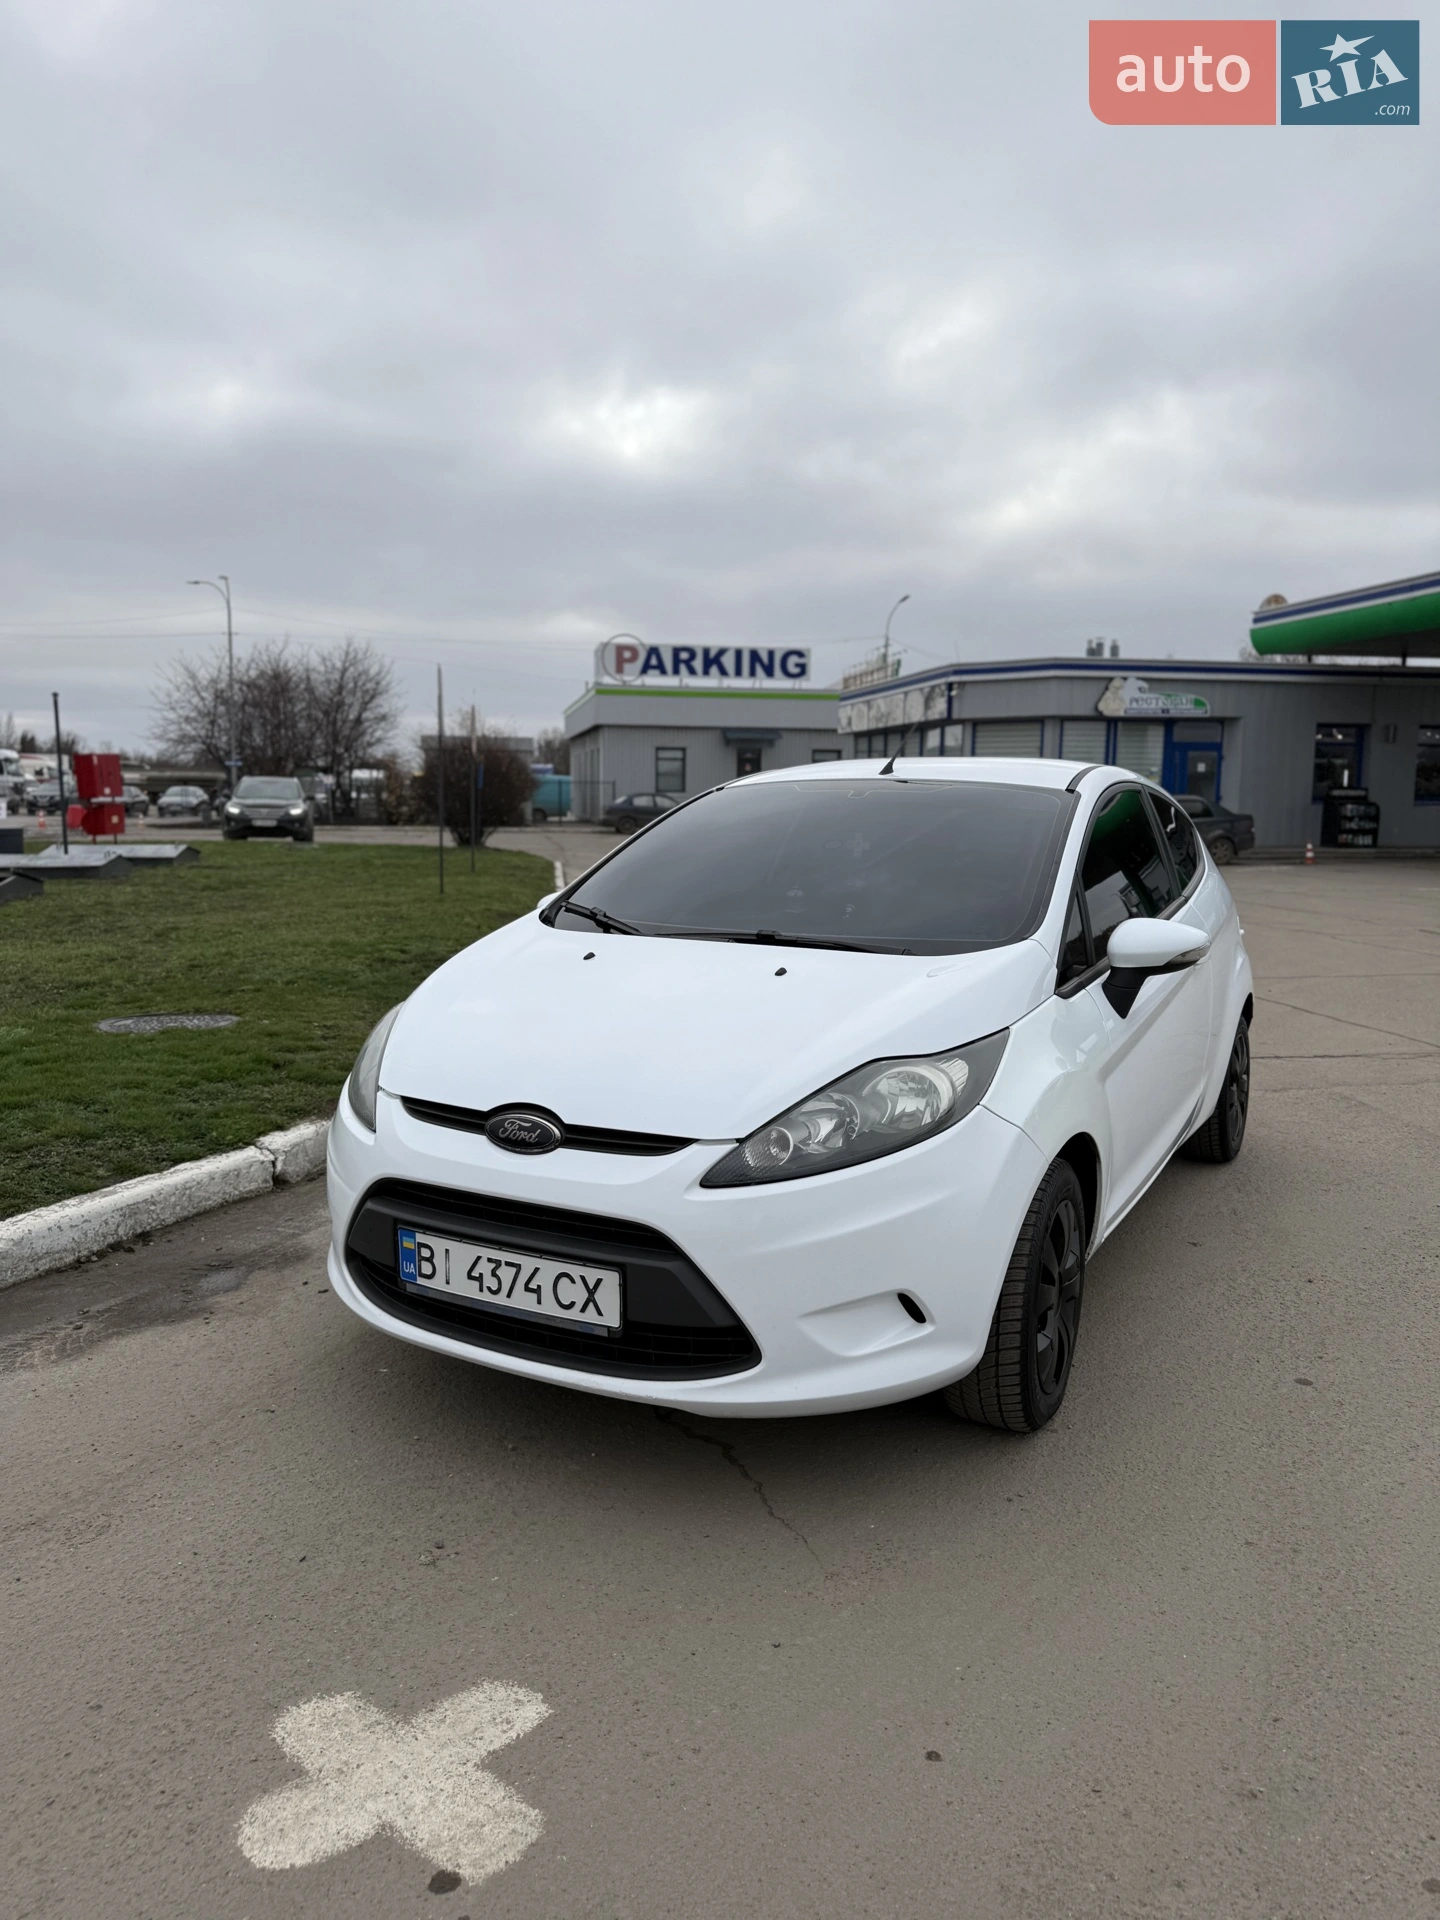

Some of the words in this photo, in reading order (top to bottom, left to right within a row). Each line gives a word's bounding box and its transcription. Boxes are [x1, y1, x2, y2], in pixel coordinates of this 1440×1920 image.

[614, 644, 808, 679] PARKING
[499, 1119, 542, 1143] Ford
[403, 1261, 416, 1274] UA
[416, 1241, 450, 1285] BI
[466, 1255, 542, 1305] 4374
[552, 1271, 604, 1317] CX
